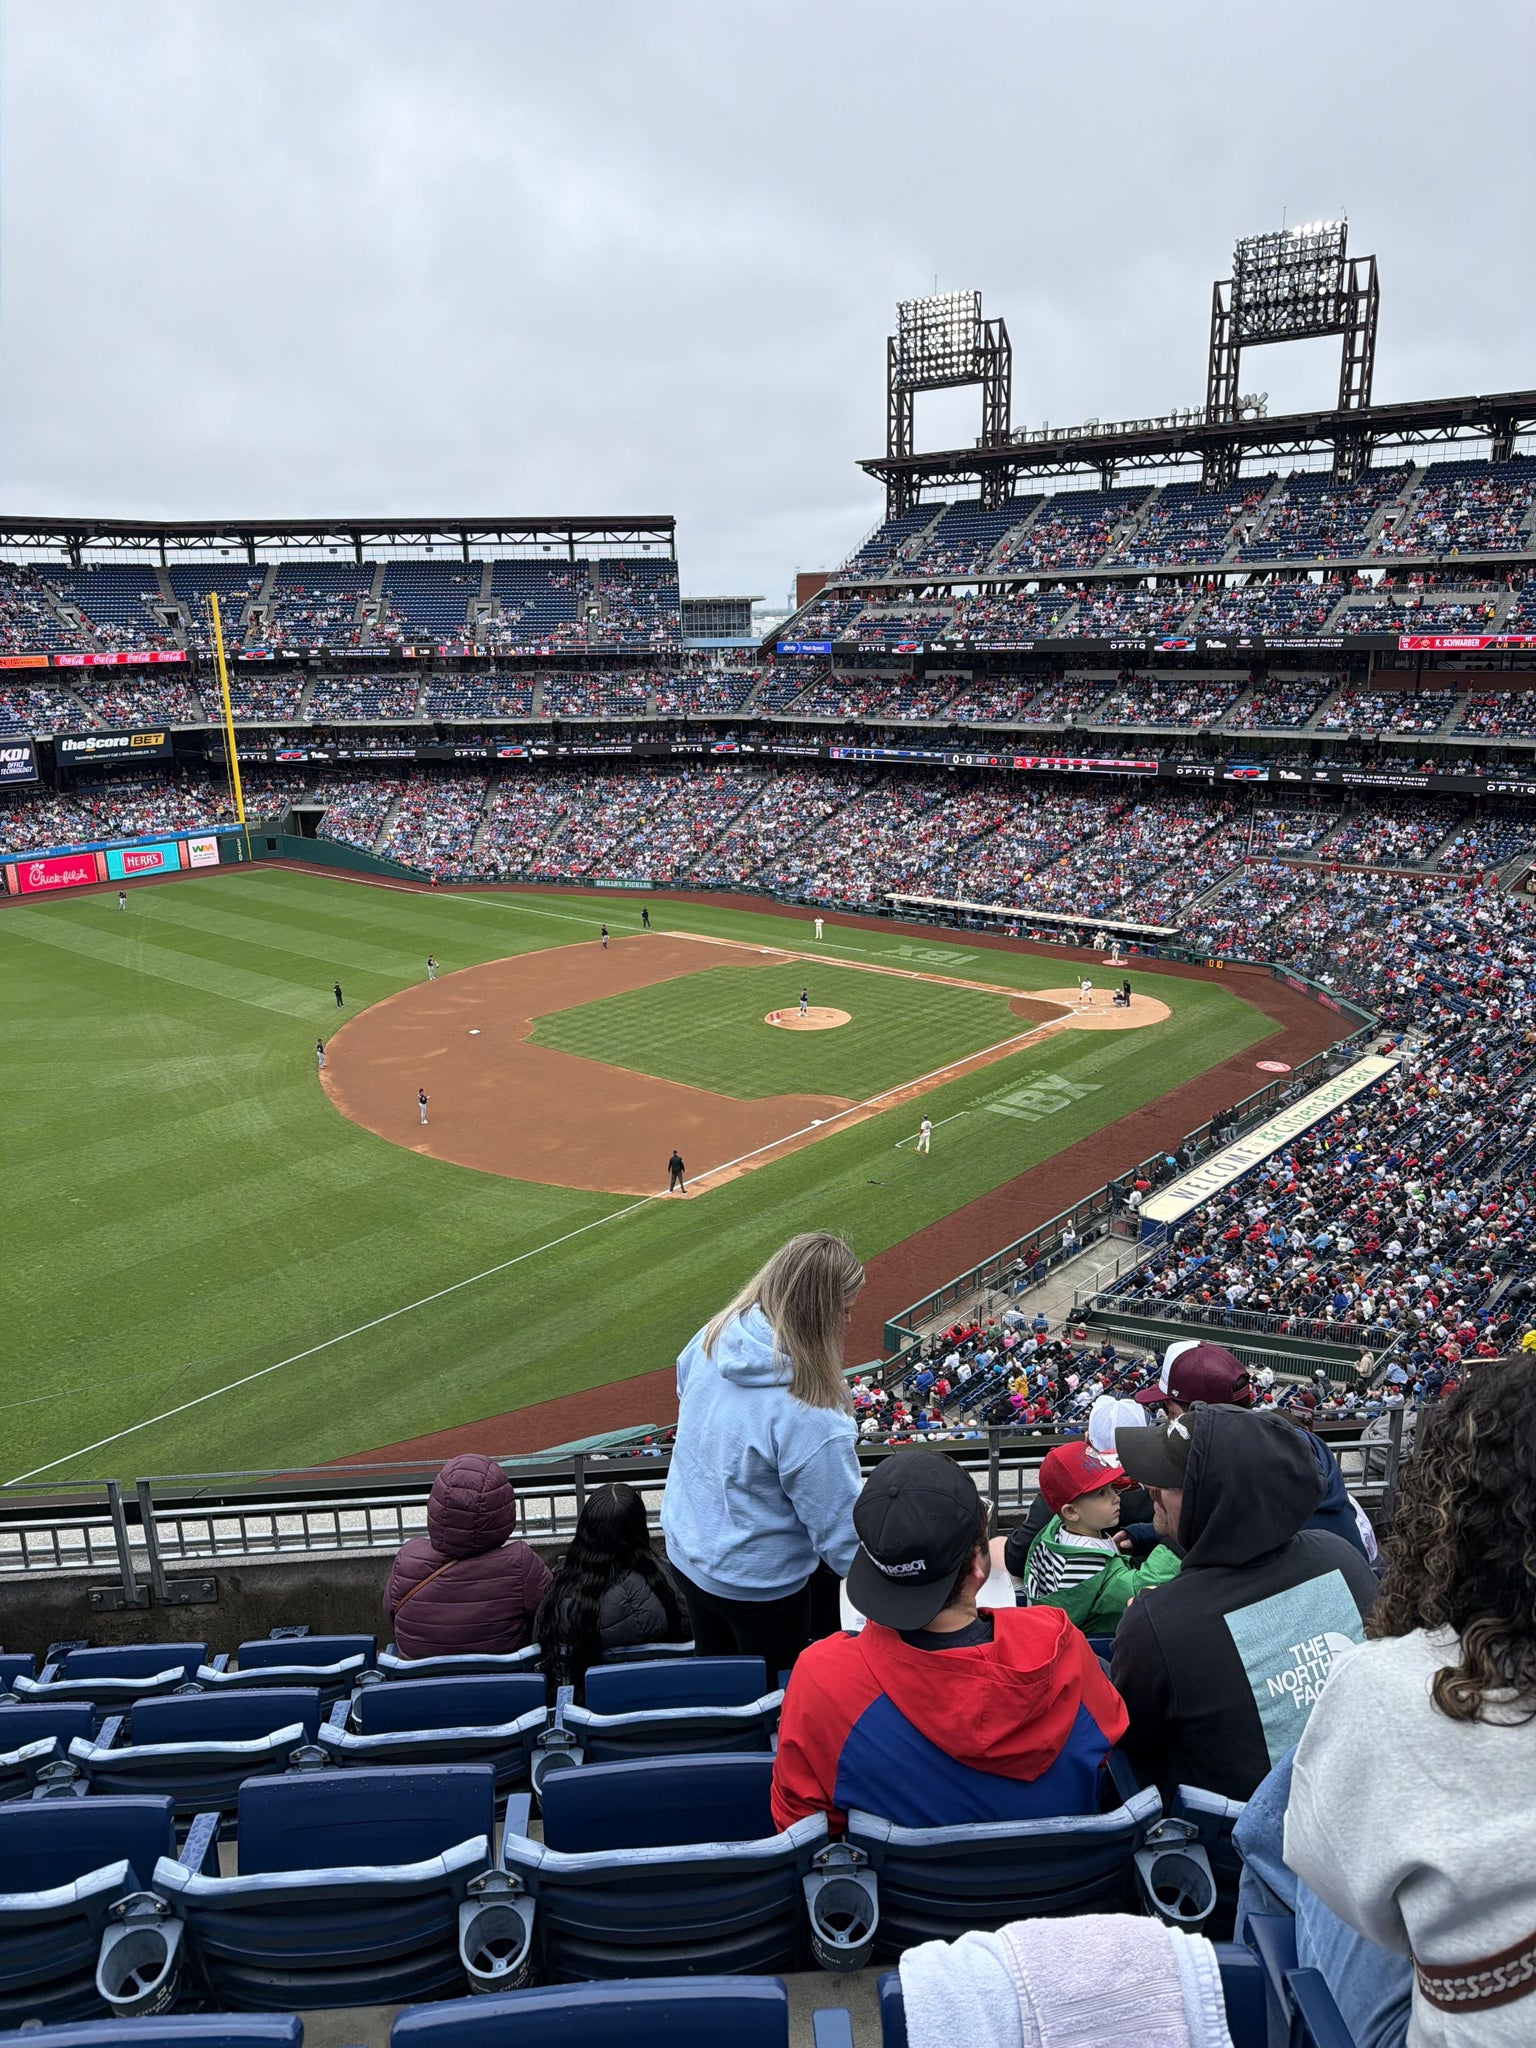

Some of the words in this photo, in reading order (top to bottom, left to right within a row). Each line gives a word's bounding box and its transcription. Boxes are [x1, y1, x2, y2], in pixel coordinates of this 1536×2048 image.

[1443, 638, 1480, 647] SCHWARBER
[62, 736, 129, 751] theScore
[133, 735, 161, 744] BET
[0, 766, 33, 776] TECHNOLOGY
[7, 761, 24, 769] OFFICE
[1487, 785, 1536, 794] OPTIQ
[192, 844, 215, 852] WM
[127, 854, 159, 866] HERR'S
[29, 863, 88, 886] Chick-fil-A
[984, 1074, 1105, 1122] IBX
[1169, 1147, 1261, 1200] WELCOME
[1271, 1102, 1328, 1134] Citizens
[1314, 1084, 1355, 1104] Bank
[1341, 1068, 1378, 1089] Park
[1288, 1634, 1328, 1664] THE
[1266, 1654, 1332, 1698] NORTH
[1292, 1678, 1327, 1710] FAC
